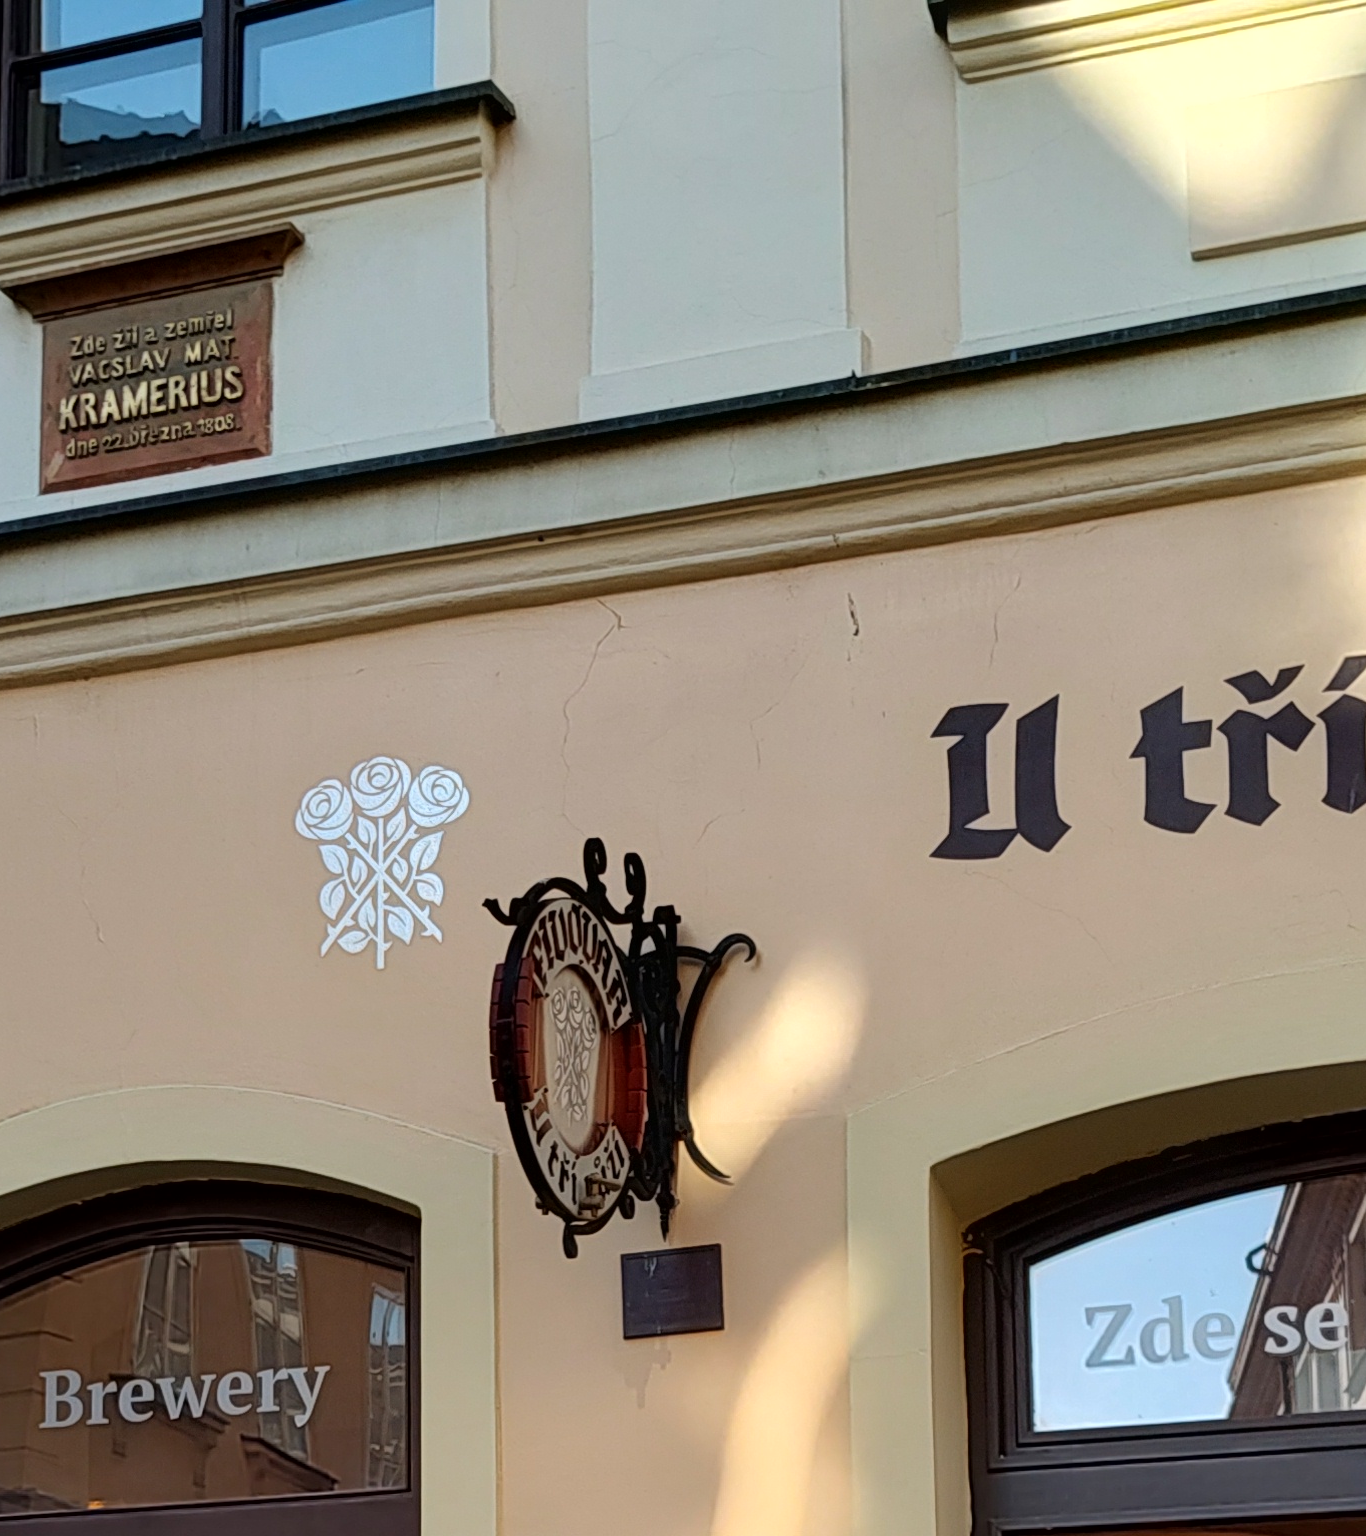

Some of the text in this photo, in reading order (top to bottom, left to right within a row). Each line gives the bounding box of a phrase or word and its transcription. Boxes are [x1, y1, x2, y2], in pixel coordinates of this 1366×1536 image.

[70, 309, 234, 359] Zde žil a zemřel
[59, 366, 244, 434] KRAMERIUS
[68, 348, 172, 387] VACSLAV
[66, 437, 98, 459] dne
[929, 694, 1072, 860] U
[1083, 1294, 1234, 1370] Zde
[1263, 1300, 1350, 1356] se
[38, 1364, 332, 1430] Brewery
